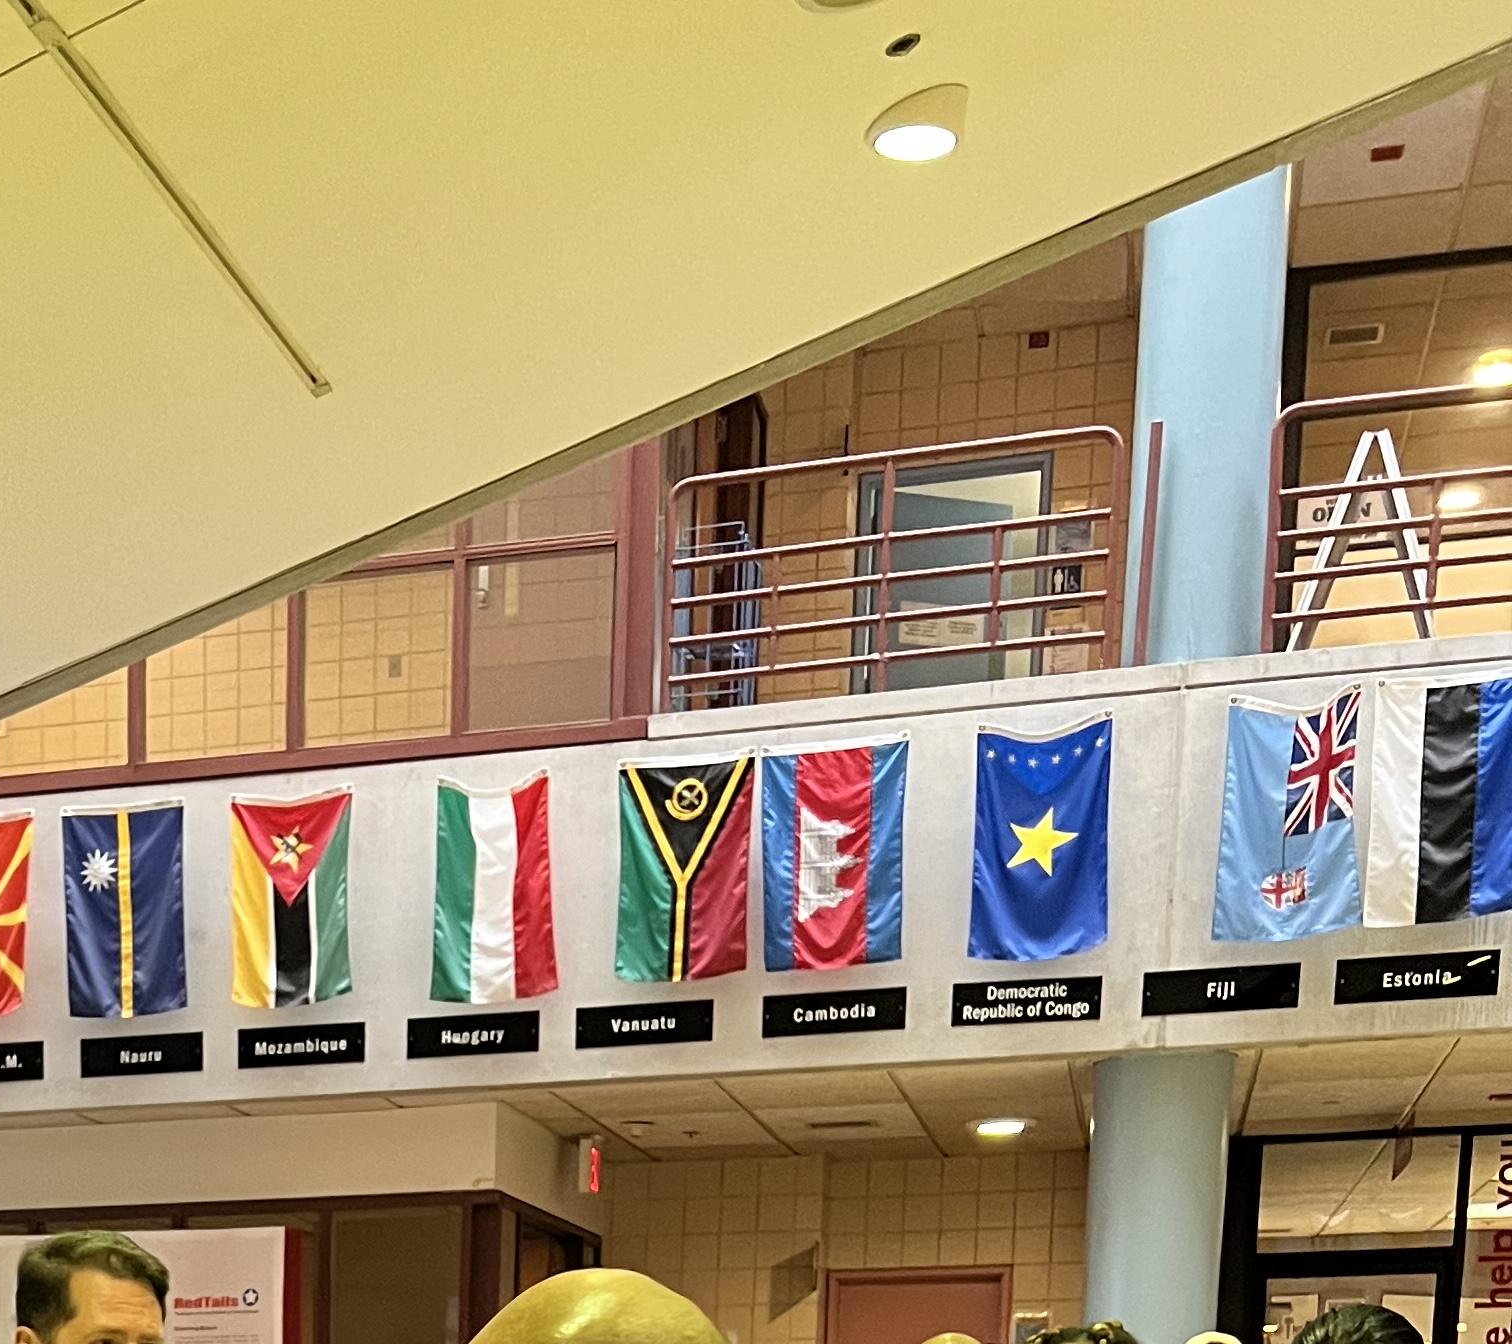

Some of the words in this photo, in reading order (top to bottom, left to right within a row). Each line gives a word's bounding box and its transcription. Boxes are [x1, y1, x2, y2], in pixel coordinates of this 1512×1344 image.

[986, 981, 1069, 1001] Democratic
[792, 1003, 877, 1024] Cambodia
[962, 998, 1024, 1022] Republic
[1026, 1000, 1044, 1017] of
[1044, 999, 1091, 1021] Congo
[611, 1015, 677, 1033] Vanuatu
[254, 1037, 348, 1057] Mozambique
[440, 1027, 505, 1047] Hungary
[119, 1048, 163, 1065] Nauru
[1473, 1228, 1512, 1309] help
